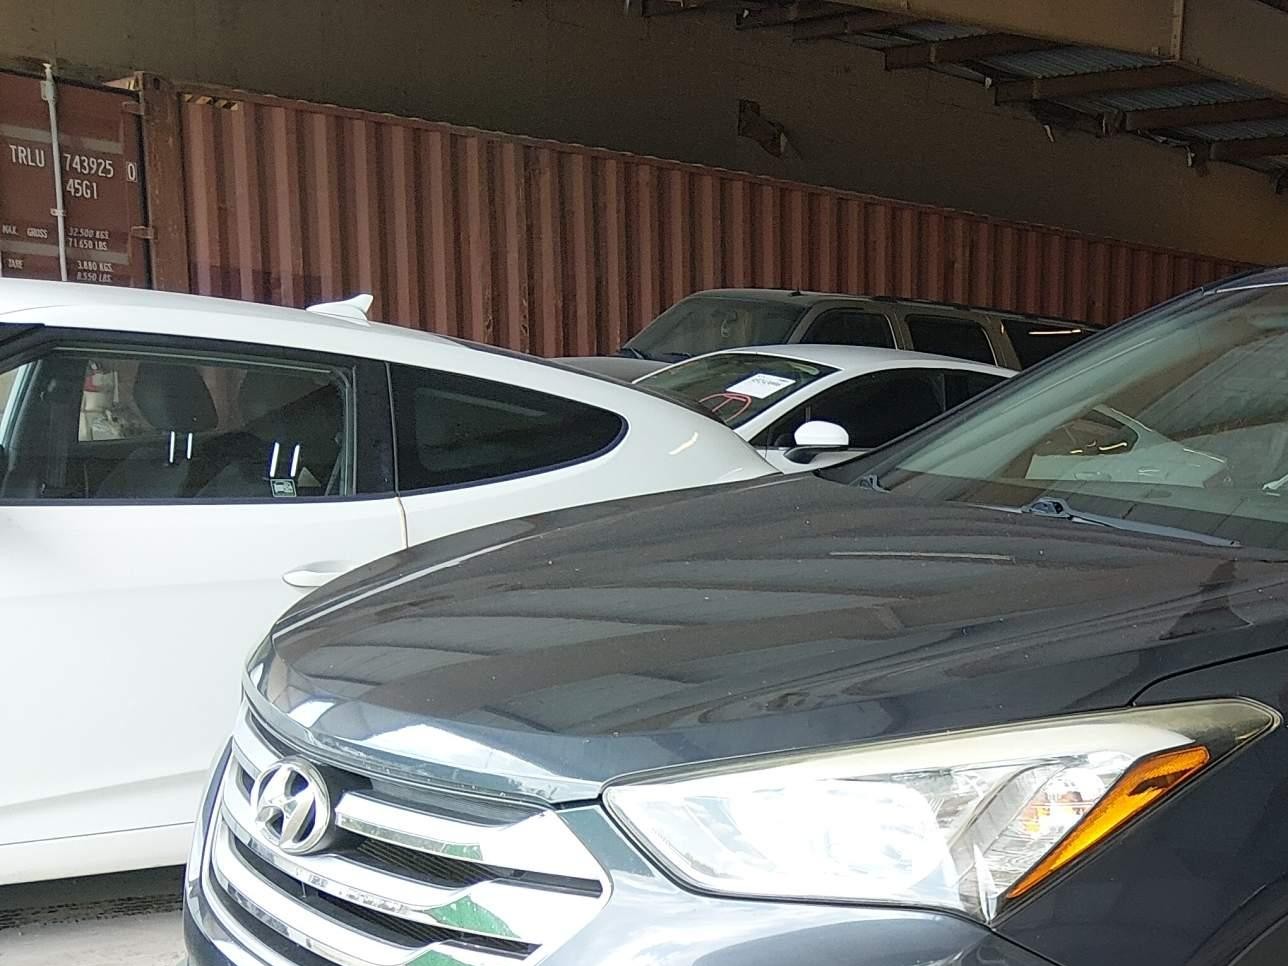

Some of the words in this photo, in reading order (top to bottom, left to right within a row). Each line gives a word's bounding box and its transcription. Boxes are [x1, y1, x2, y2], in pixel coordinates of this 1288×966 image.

[9, 144, 45, 167] TRLU
[64, 154, 114, 178] 743925
[66, 179, 98, 199] 45G1
[27, 227, 48, 238] GROSS
